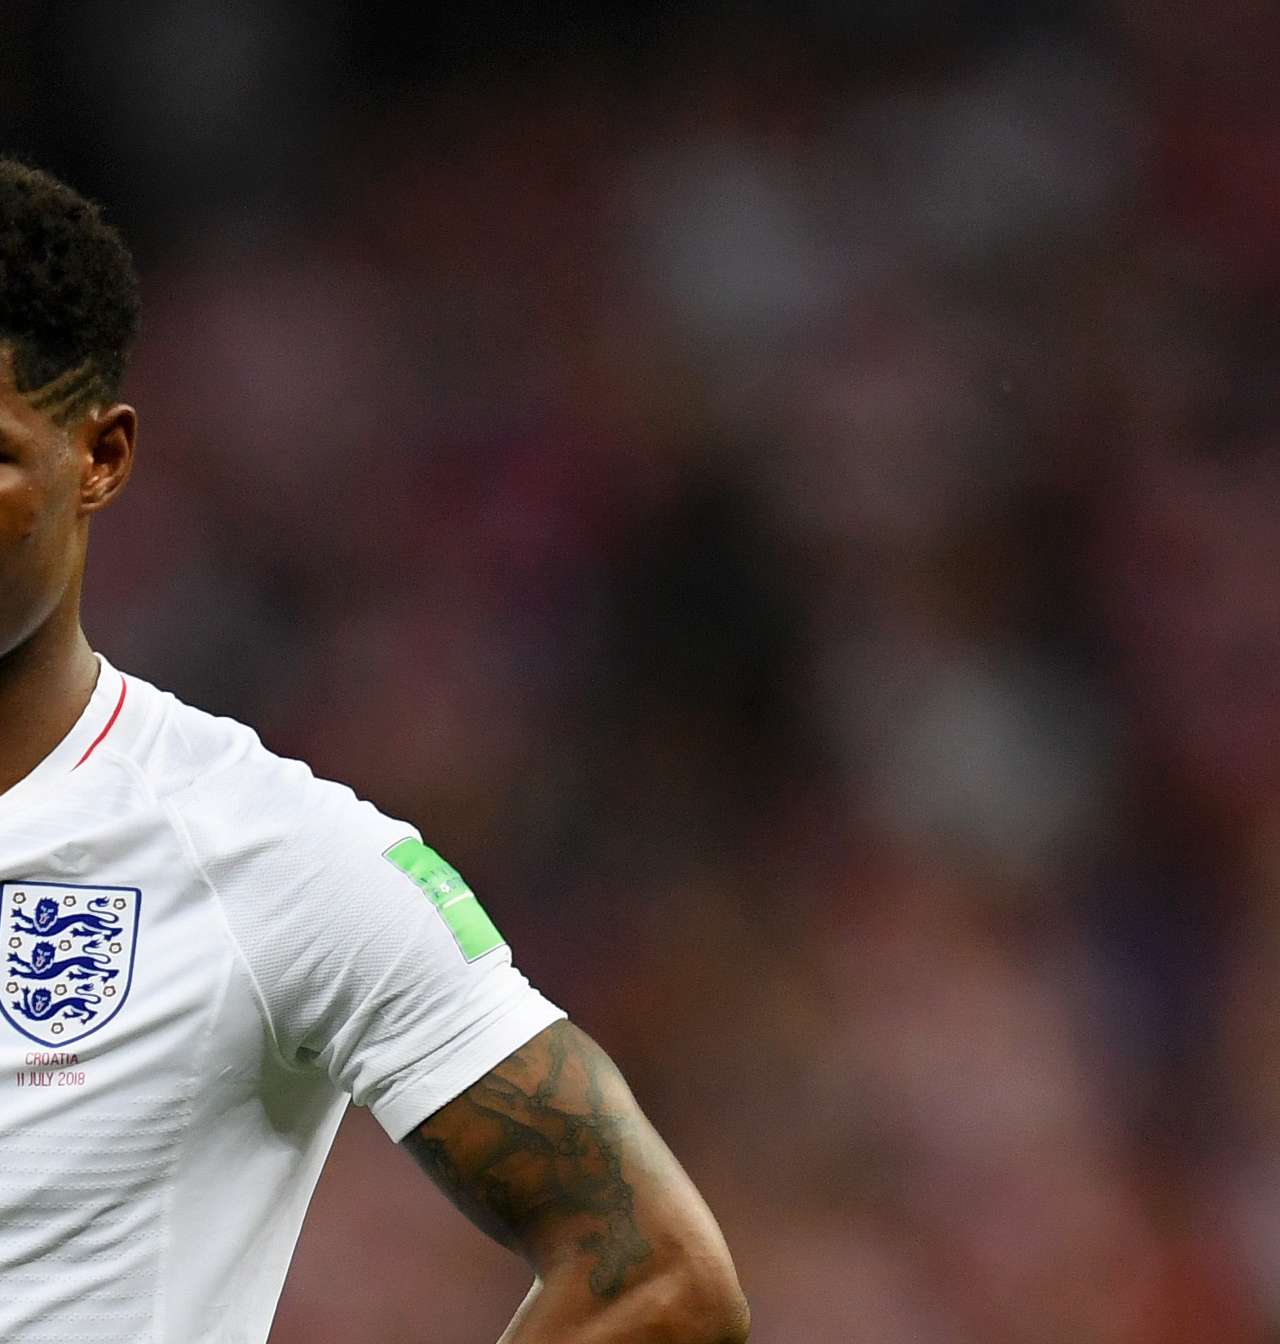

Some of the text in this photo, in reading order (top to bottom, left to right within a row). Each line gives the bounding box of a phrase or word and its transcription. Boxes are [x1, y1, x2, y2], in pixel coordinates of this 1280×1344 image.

[25, 1052, 79, 1066] CROATIA
[28, 1071, 54, 1087] JULY
[57, 1071, 86, 1087] 2018
